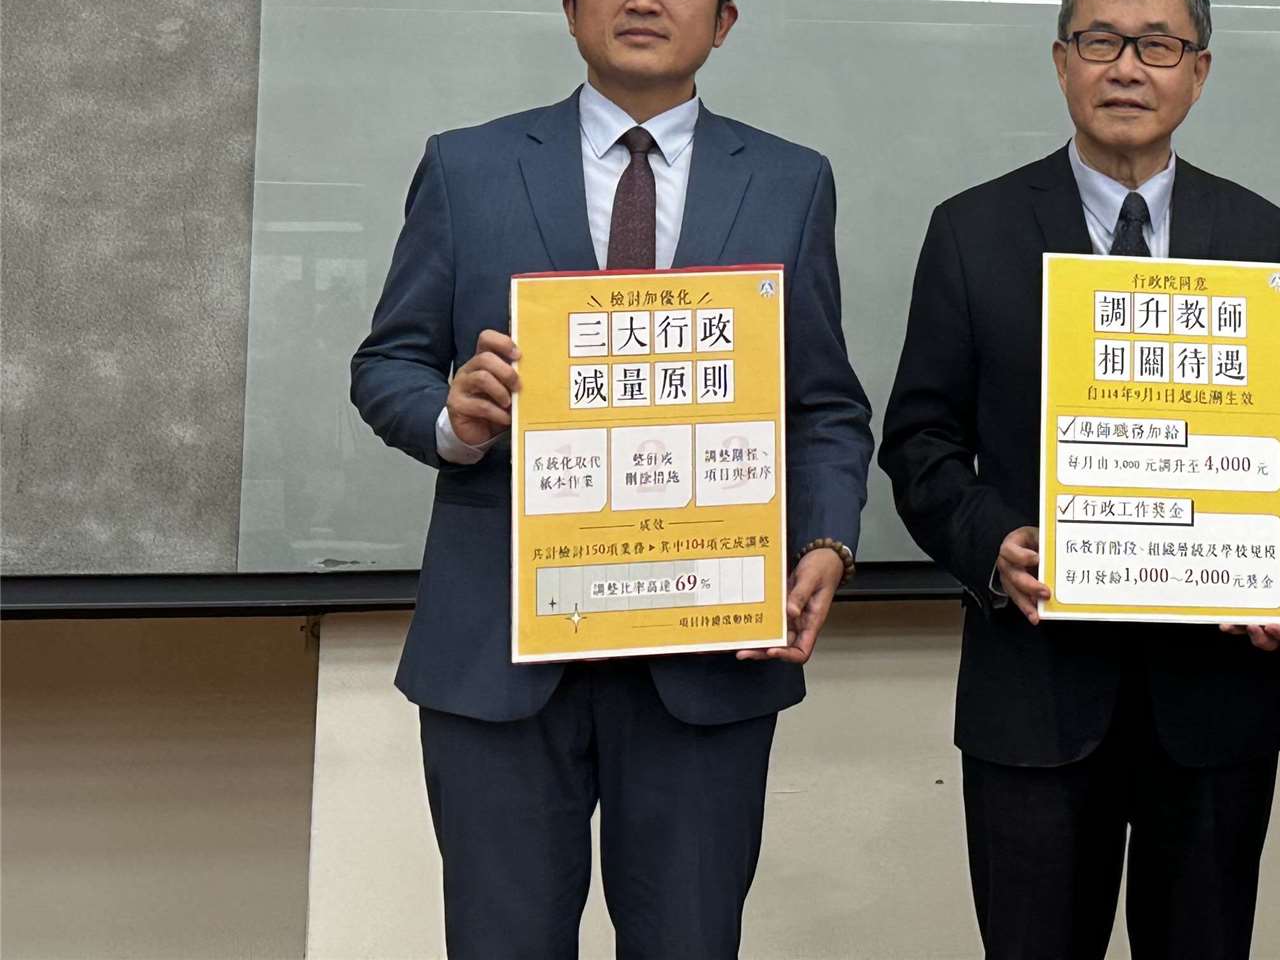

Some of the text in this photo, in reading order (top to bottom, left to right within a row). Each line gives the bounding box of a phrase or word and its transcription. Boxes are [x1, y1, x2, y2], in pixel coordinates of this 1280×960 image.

[1131, 273, 1209, 291] 行政院同意
[610, 289, 692, 307] 檢討加優化
[1100, 295, 1242, 333] 調升教師
[574, 312, 733, 351] 三大行政
[1099, 344, 1245, 380] 相關待遇
[574, 363, 728, 405] 減量原則
[1087, 385, 1254, 406] 自114年9月1日起追溯生效
[1080, 421, 1180, 441] 導師職務加給
[1083, 499, 1185, 519] 行政工作獎金
